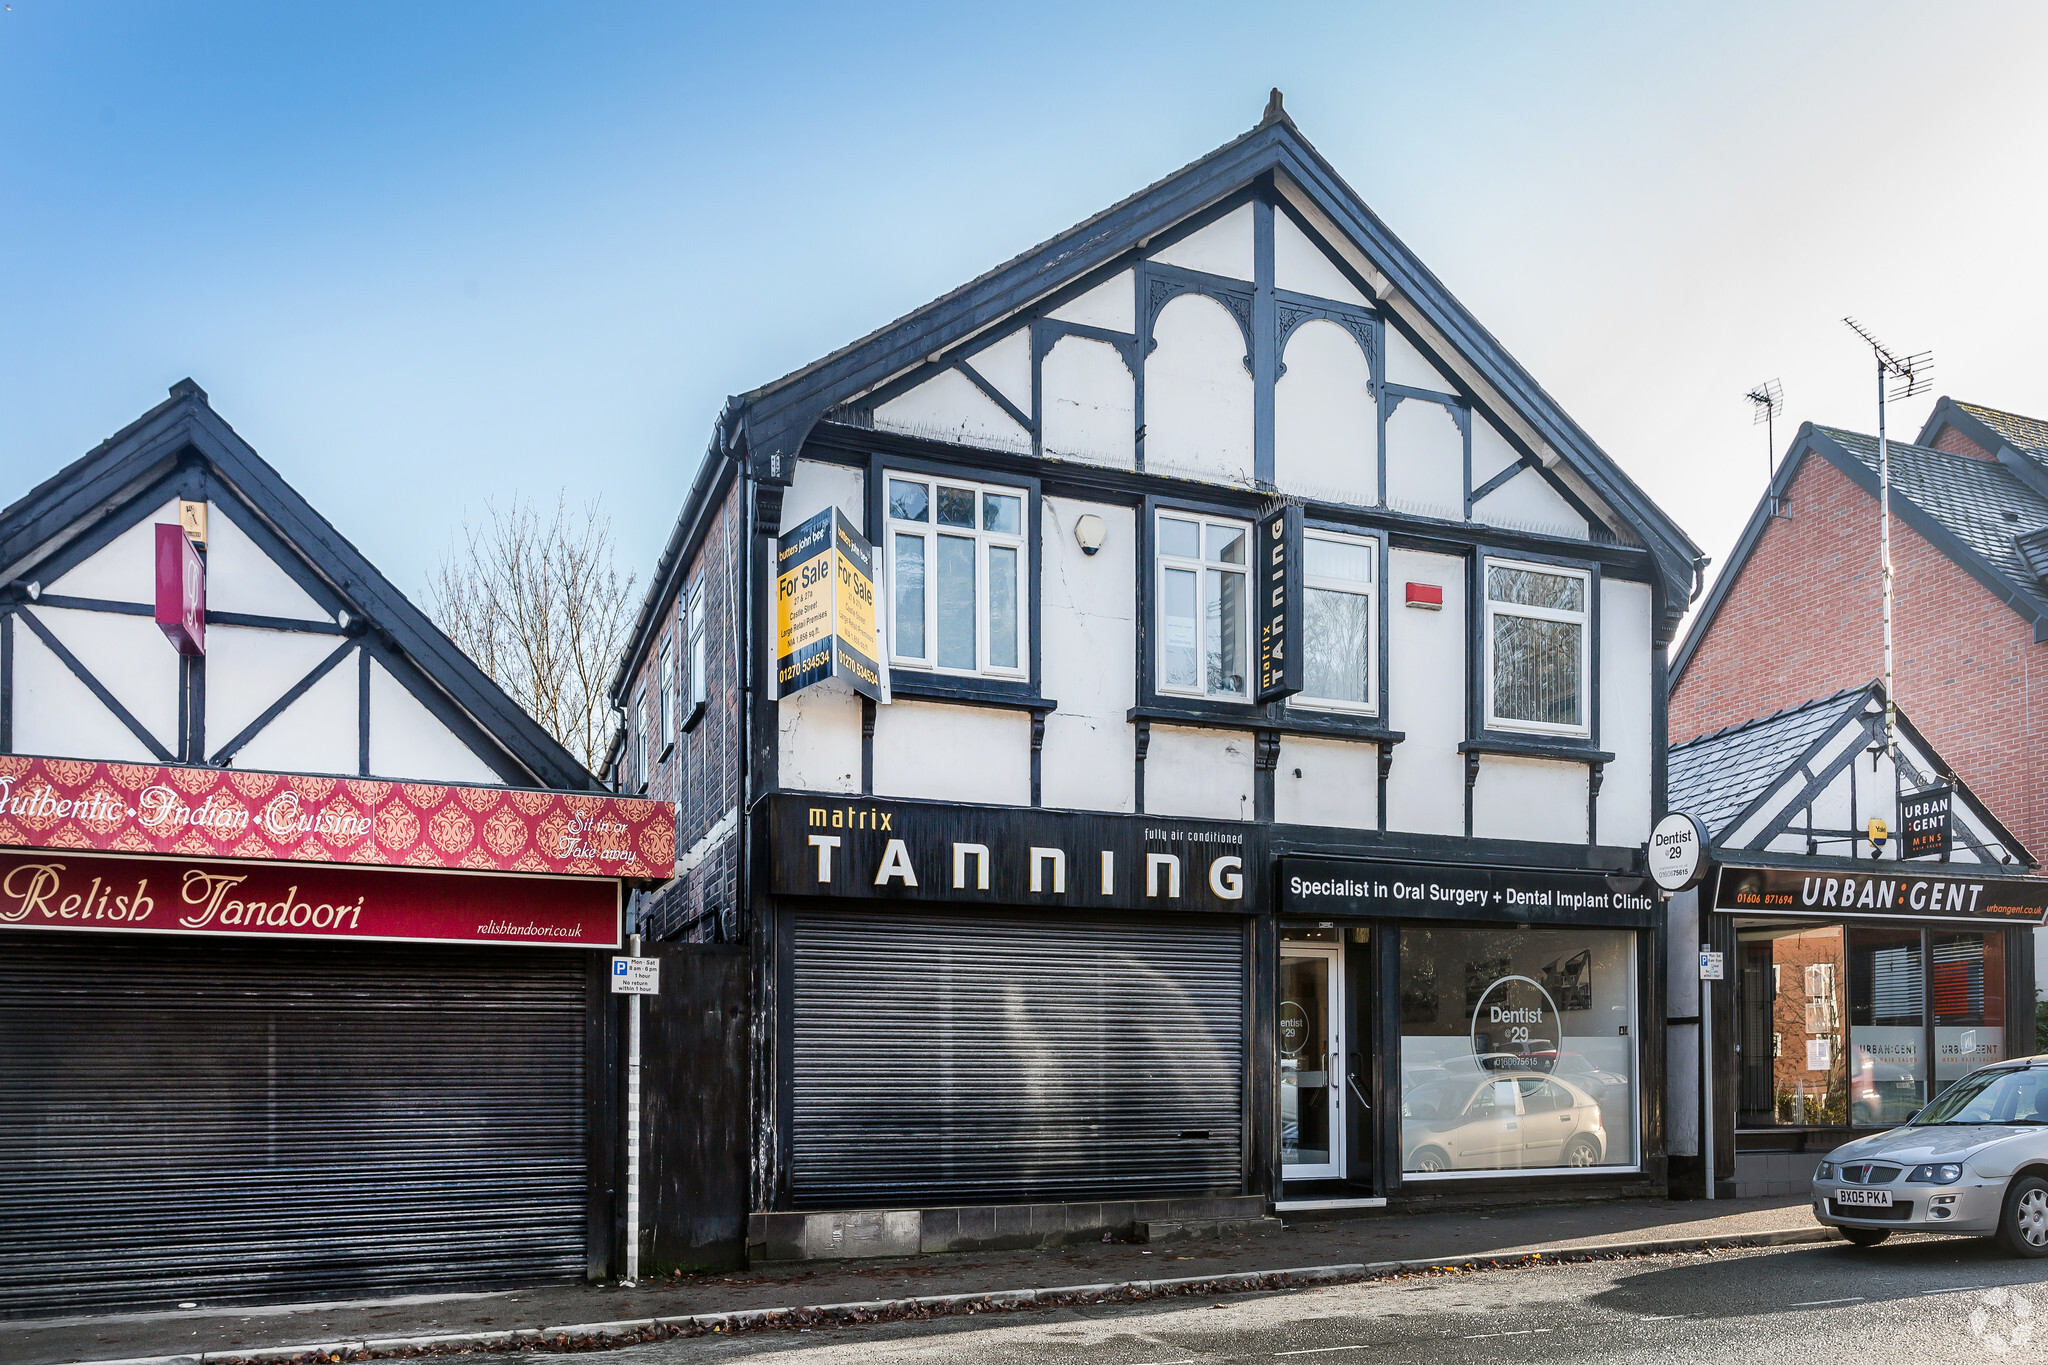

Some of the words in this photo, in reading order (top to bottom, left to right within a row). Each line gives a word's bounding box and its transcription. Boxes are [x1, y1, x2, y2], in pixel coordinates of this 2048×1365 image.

[779, 544, 798, 561] butters
[798, 534, 812, 553] john
[812, 528, 824, 542] bee
[780, 575, 799, 601] For
[801, 559, 829, 588] Sale
[837, 556, 851, 587] For
[853, 572, 872, 606] Sale
[790, 608, 803, 620] Castle
[804, 600, 818, 613] Street
[781, 627, 792, 638] Large
[806, 610, 828, 625] Premises
[779, 664, 801, 684] 01270
[802, 650, 830, 673] 534534
[838, 648, 855, 673] 01270
[857, 662, 879, 687] 534534
[1262, 625, 1271, 688] matrix
[138, 785, 250, 828] Indian
[265, 790, 372, 835] Cuisine
[809, 806, 893, 832] matrix
[1904, 798, 1948, 819] URBAN
[567, 809, 593, 834] Sit
[597, 819, 610, 833] in
[614, 822, 628, 833] or
[1145, 828, 1167, 842] fully
[1171, 830, 1184, 841] air
[1188, 831, 1243, 845] conditioned
[1656, 829, 1691, 846] Dentist
[1912, 833, 1942, 846] MENS
[558, 836, 595, 859] Take
[601, 850, 637, 865] away
[0, 863, 154, 922] Relish
[180, 869, 366, 929] Tandoori
[1290, 876, 1370, 898] Specialist
[1374, 880, 1388, 898] in
[1392, 881, 1425, 900] Oral
[1429, 884, 1488, 907] Surgery
[1506, 888, 1552, 906] Dental
[1556, 890, 1609, 911] Implant
[1613, 893, 1652, 911] Clinic
[1737, 893, 1761, 904] 01606
[1764, 894, 1793, 905] 871694
[1986, 903, 2043, 916] urbangent.co.uk
[477, 920, 582, 938] relishtandoori.co.uk
[617, 962, 626, 975] P
[1280, 1018, 1303, 1028] entist
[1490, 1006, 1543, 1023] Dentist
[1495, 1057, 1538, 1067] 0160675615
[1840, 1191, 1864, 1203] BX05
[1867, 1191, 1888, 1204] PKA
